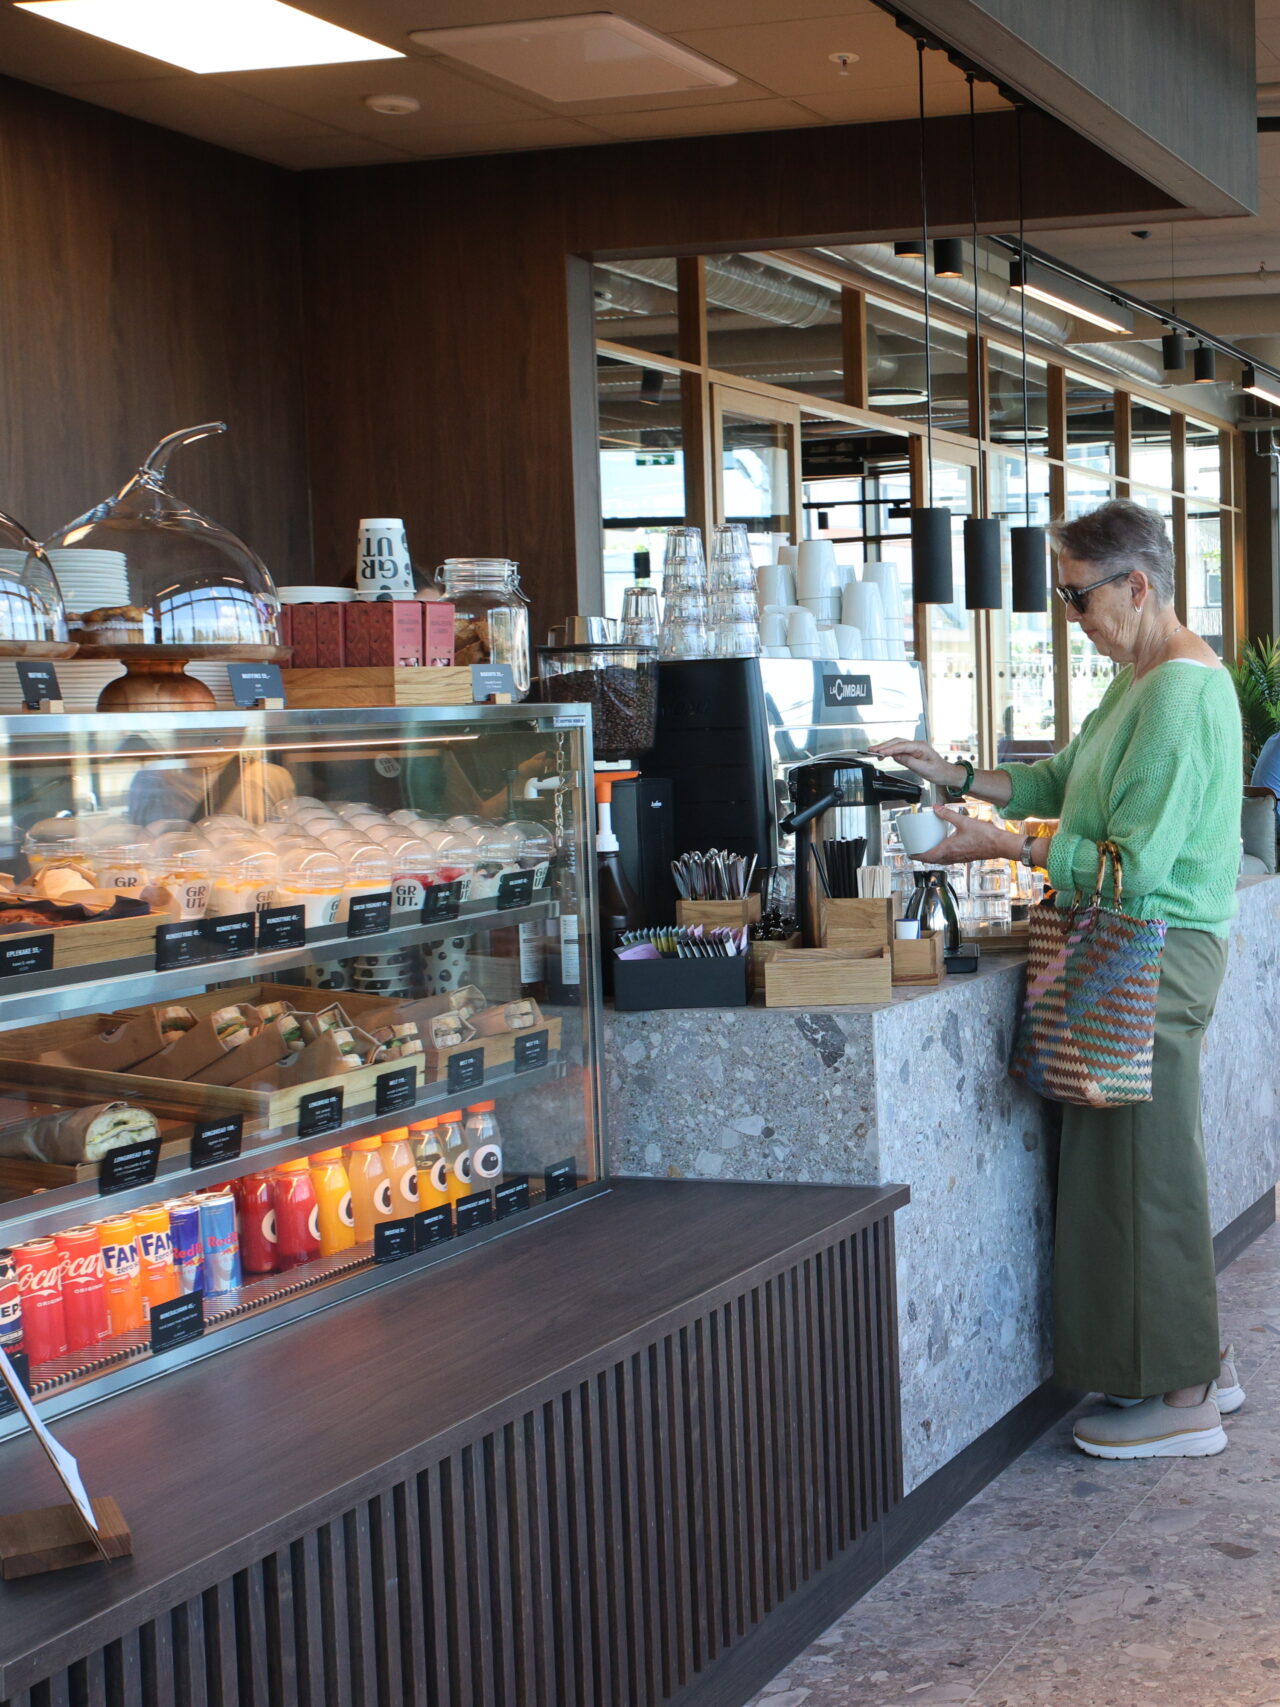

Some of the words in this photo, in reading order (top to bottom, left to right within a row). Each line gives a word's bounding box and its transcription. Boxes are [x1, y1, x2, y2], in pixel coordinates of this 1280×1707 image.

[361, 559, 398, 580] GR
[836, 679, 867, 701] CIMBALI
[186, 886, 206, 898] GR
[396, 885, 417, 896] GR
[186, 898, 206, 909] UT.
[397, 896, 418, 907] UT.
